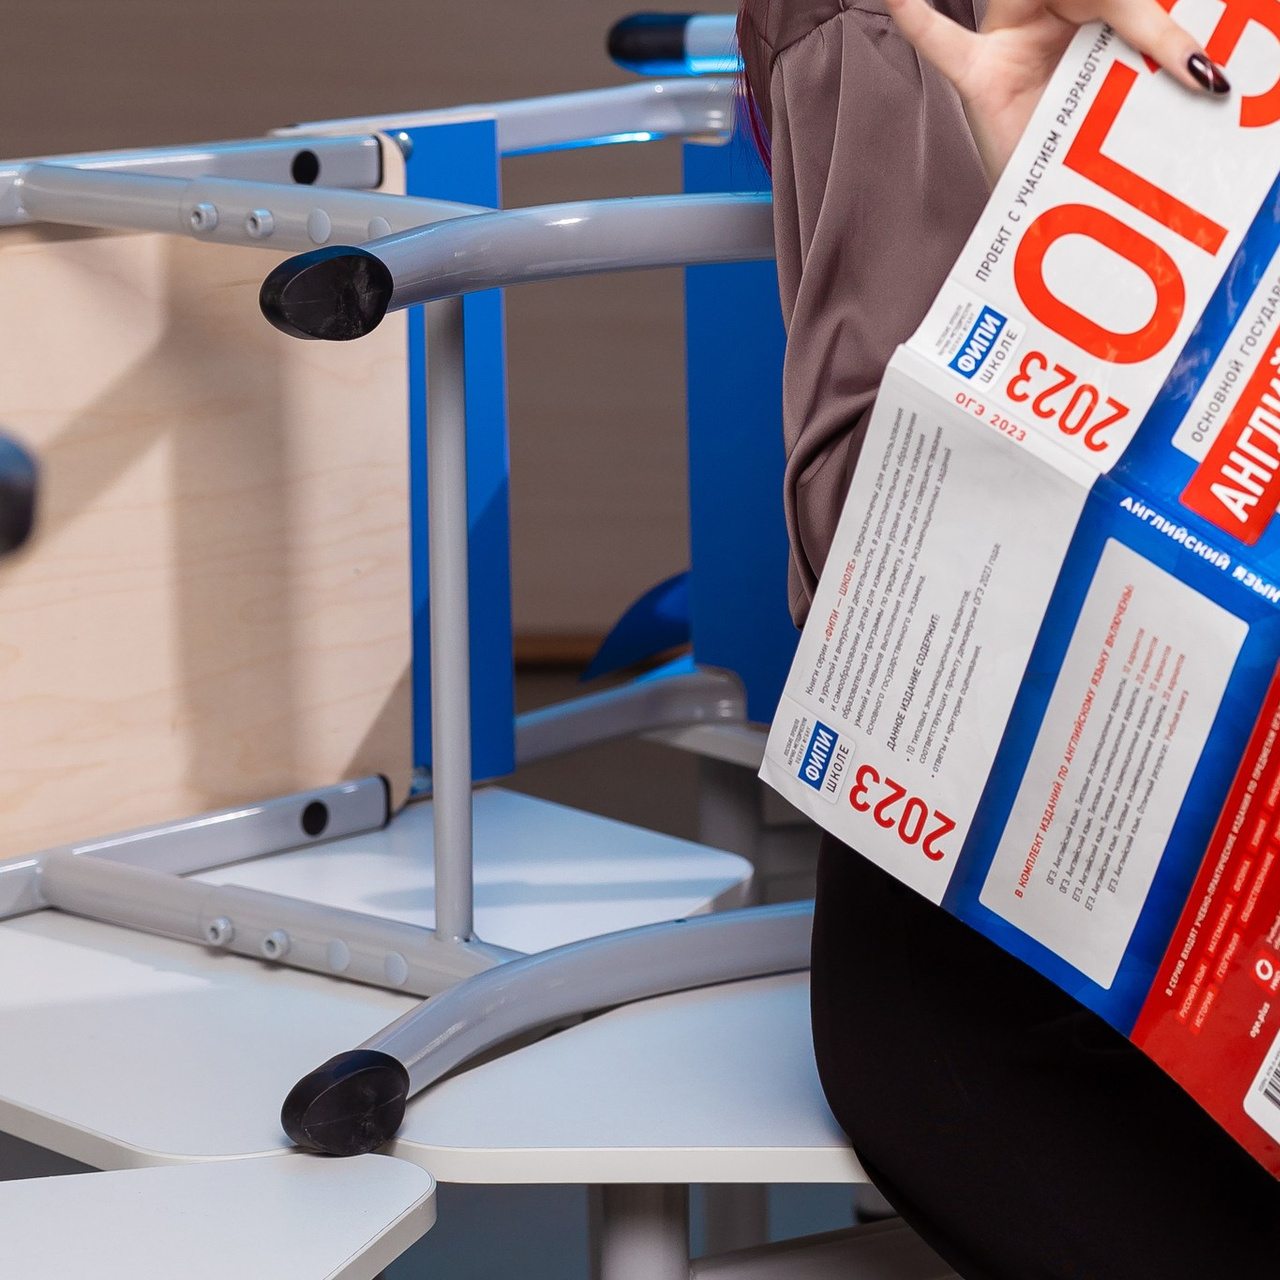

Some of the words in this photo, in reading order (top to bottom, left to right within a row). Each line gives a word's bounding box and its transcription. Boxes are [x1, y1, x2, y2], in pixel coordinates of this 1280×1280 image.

[976, 226, 1011, 281] ПРОЕКТ
[1008, 211, 1020, 222] С
[1016, 131, 1060, 205] УЧАСТИЕМ
[952, 311, 1003, 376] ФИПИ
[977, 327, 1019, 385] ШКОЛЕ
[955, 392, 986, 418] ОГЭ
[990, 412, 1027, 442] 2023
[1007, 352, 1128, 451] 2023
[1192, 360, 1243, 442] ОСНОВНОЙ
[877, 405, 907, 474] использования
[874, 469, 886, 491] для
[821, 662, 836, 697] урочной
[835, 606, 855, 654] внеурочной
[872, 468, 900, 538] дополнительном
[894, 409, 920, 469] образовании
[854, 491, 878, 556] предназначены
[1119, 495, 1232, 572] АНГЛИЙСКИЙ
[833, 632, 860, 704] самообразовании
[858, 607, 869, 632] детей
[867, 589, 875, 607] для
[873, 543, 891, 589] измерения
[887, 512, 901, 543] уровня
[899, 474, 914, 510] качества
[973, 587, 987, 607] ОГЭ
[978, 562, 995, 590] 2023
[816, 644, 828, 668] серии
[956, 607, 980, 658] демоверсии
[805, 669, 819, 695] Книги
[865, 693, 886, 737] основного
[880, 614, 913, 694] государственного
[886, 709, 907, 751] ДАННОЕ
[900, 666, 923, 713] ИЗДАНИЕ
[915, 610, 942, 667] СОДЕРЖИТ:
[906, 745, 916, 756] 10
[912, 710, 927, 744] типовых
[924, 636, 954, 710] экзаменационных
[944, 657, 961, 692] проекту
[803, 726, 833, 785] ФИПИ
[918, 690, 950, 765] соответствующих
[933, 743, 946, 772] ответы
[946, 696, 962, 735] критерии
[825, 742, 849, 794] ШКОЛЕ
[1015, 889, 1023, 898] В
[1019, 833, 1044, 888] КОМПЛЕКТ
[1038, 782, 1065, 832] ИЗДАНИЙ
[1058, 764, 1070, 780] ПО
[1064, 685, 1099, 766] АНГЛИЙСКОМУ
[1089, 646, 1113, 689] ЯЗЫКУ
[851, 766, 954, 860] 2023
[1228, 789, 1253, 835] ИЗДАНИЯ
[1191, 829, 1237, 928] УЧЕБНО-ПРАКТИЧЕСКИЕ
[1178, 925, 1199, 961] ВХОДЯТ
[1206, 901, 1234, 954] МАТЕМАТИКА
[1163, 985, 1174, 998] В
[1166, 956, 1186, 990] СЕРИЮ
[1178, 982, 1199, 1019] РУССКИЙ
[1192, 961, 1208, 986] ЯЗЫК
[1247, 999, 1272, 1040] oge.plus
